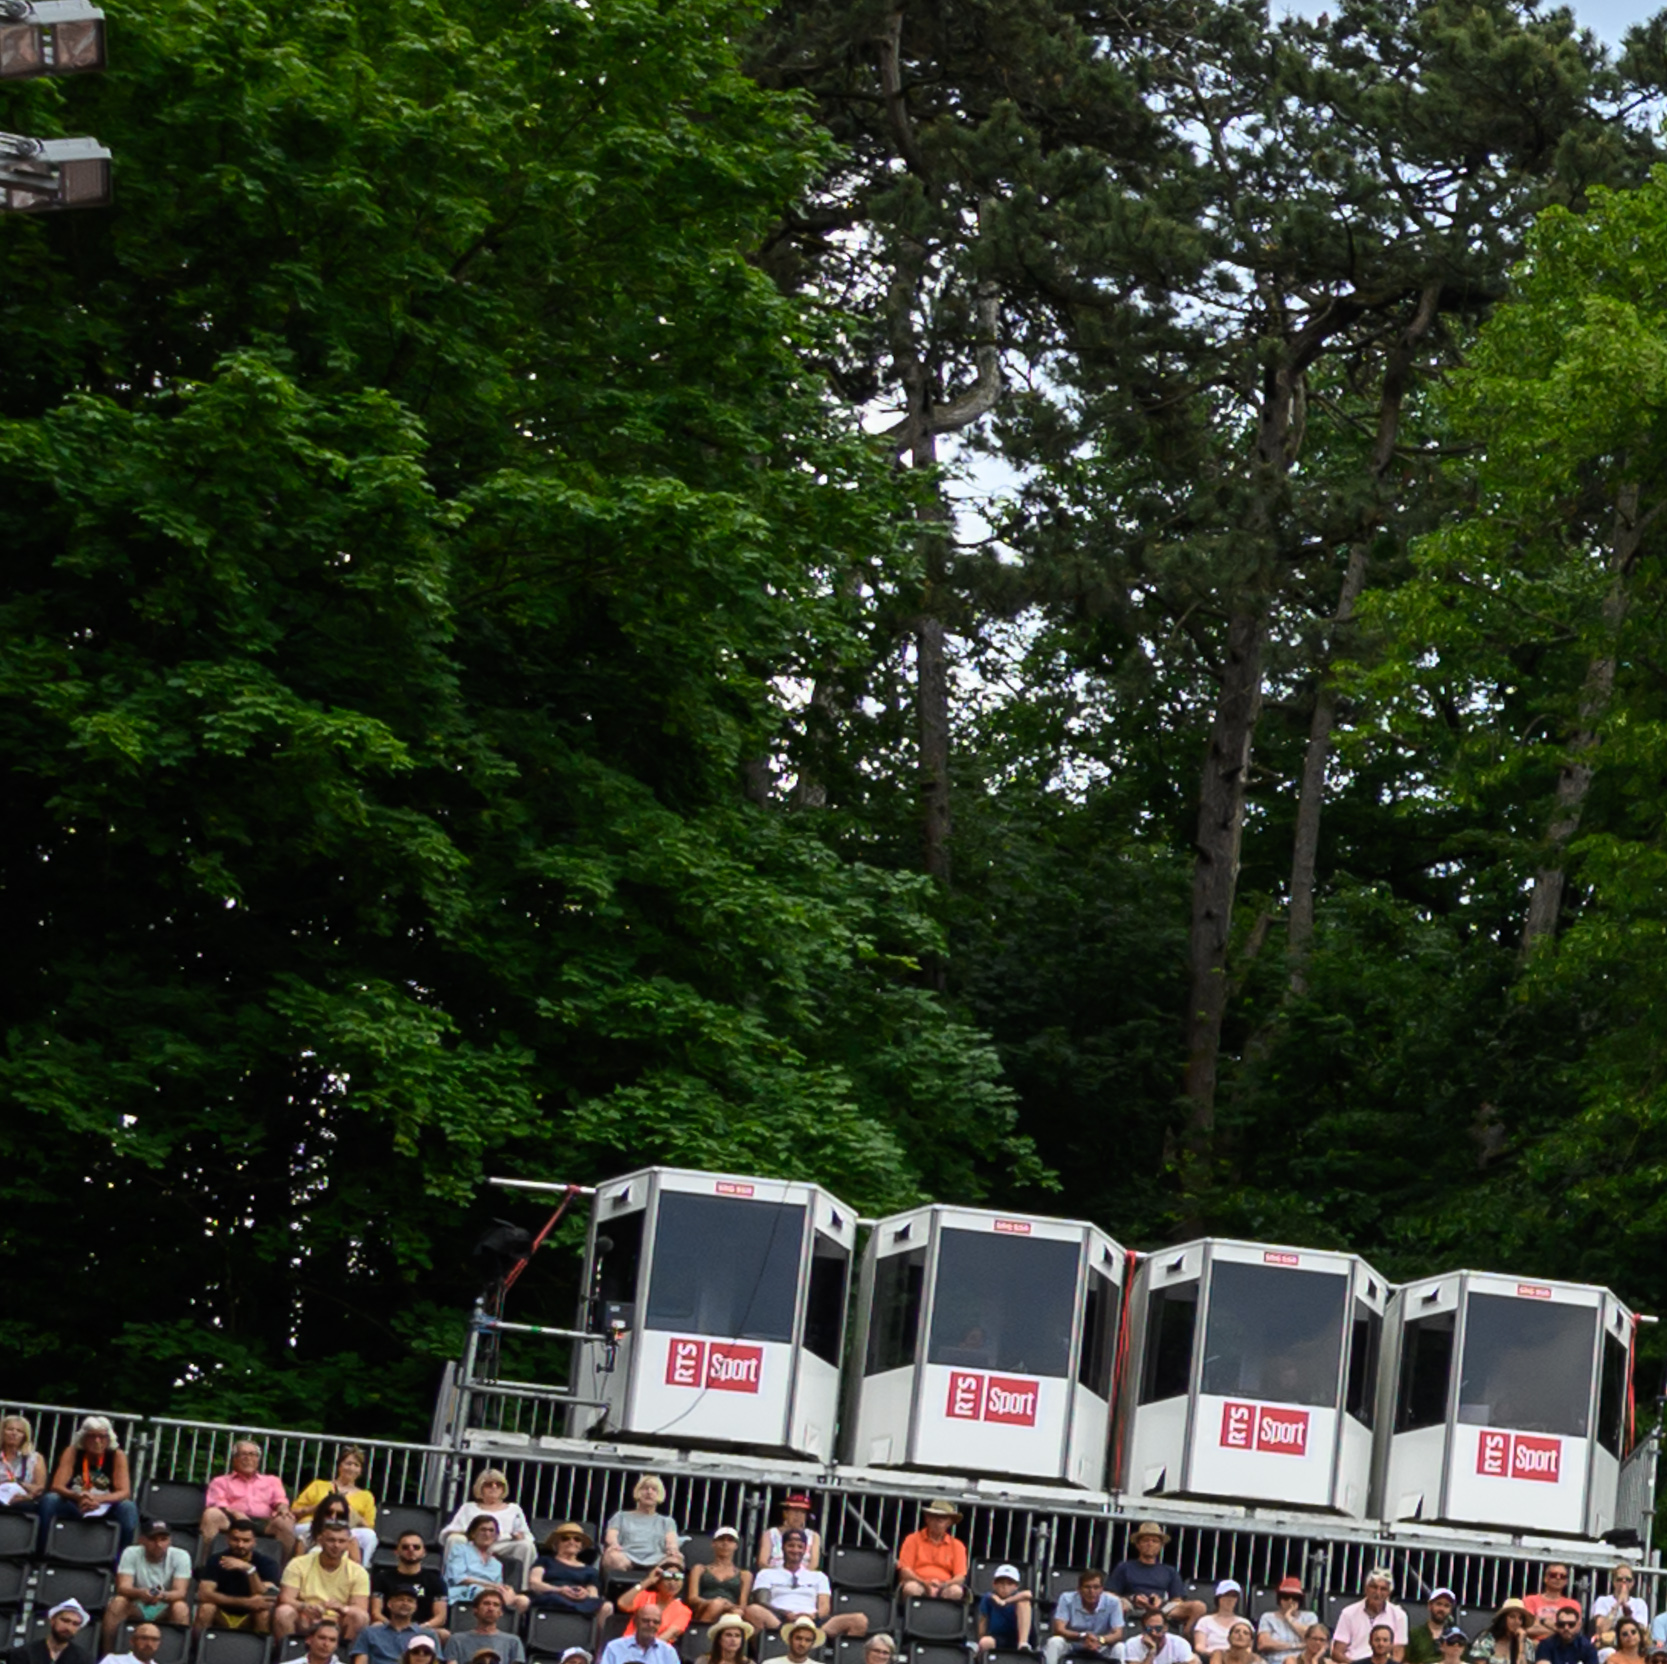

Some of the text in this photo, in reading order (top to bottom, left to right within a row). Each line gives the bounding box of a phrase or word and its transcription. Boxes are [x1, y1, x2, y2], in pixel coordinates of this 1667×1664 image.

[674, 1342, 698, 1383] RTS
[710, 1352, 759, 1383] Sport
[954, 1376, 977, 1416] RTS
[988, 1386, 1035, 1416] Sport
[1228, 1406, 1250, 1446] RTS
[1260, 1416, 1306, 1446] Sport
[1484, 1434, 1505, 1474] RTS
[1515, 1444, 1559, 1474] Sport
